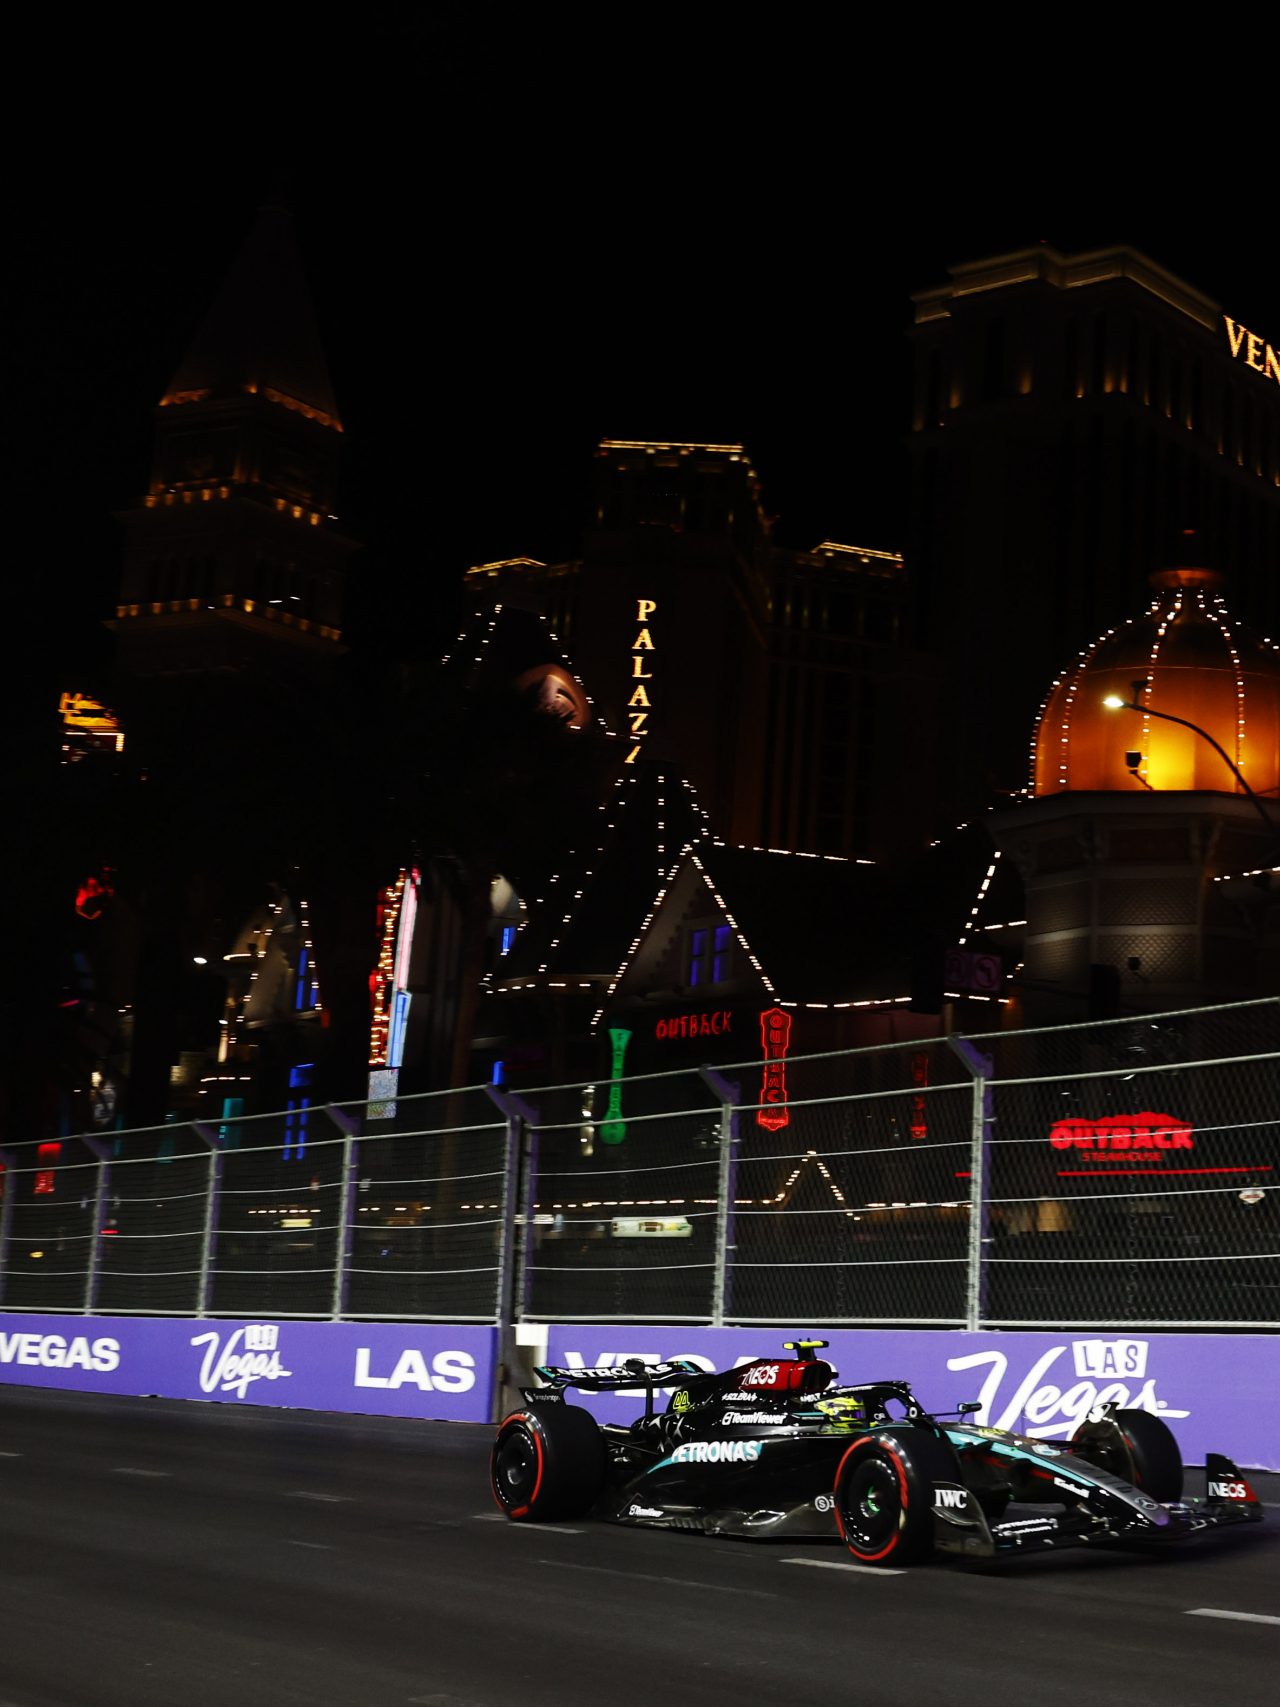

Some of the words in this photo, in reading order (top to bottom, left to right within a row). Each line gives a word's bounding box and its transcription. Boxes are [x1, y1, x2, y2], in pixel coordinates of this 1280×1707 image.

[655, 1010, 735, 1041] OUTBACK
[1049, 1126, 1194, 1150] OUTBACK
[191, 1329, 292, 1399] Vegas
[1080, 1342, 1141, 1376] LAS
[354, 1347, 476, 1393] LAS
[558, 1363, 673, 1379] PETROAS
[741, 1365, 779, 1386] INEOS
[731, 1412, 788, 1424] TeamViewer
[672, 1441, 760, 1462] PETRONAS
[934, 1489, 967, 1509] IWC
[1208, 1481, 1247, 1498] INEOS
